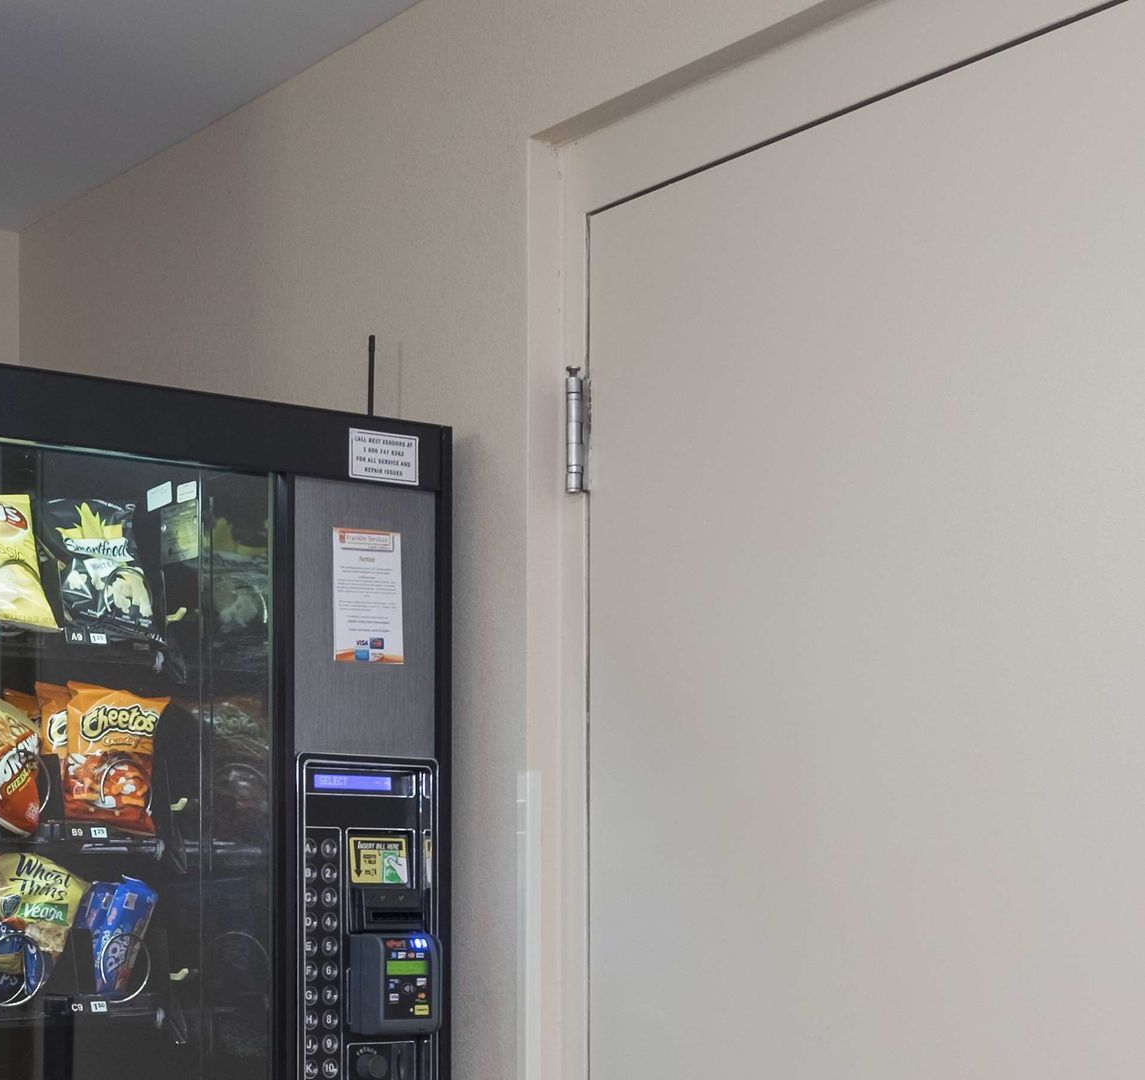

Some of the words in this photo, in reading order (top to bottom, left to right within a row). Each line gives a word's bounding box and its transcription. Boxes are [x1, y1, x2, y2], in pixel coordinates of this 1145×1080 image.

[378, 458, 399, 466] SERVICE
[384, 469, 403, 477] ISSUES
[64, 537, 128, 557] Smartfood
[71, 633, 83, 641] A9
[82, 705, 157, 740] Cheetos
[320, 776, 347, 786] SELECT
[16, 854, 71, 888] Wheat
[10, 877, 67, 902] Thins
[71, 1003, 84, 1011] C9
[356, 1046, 377, 1056] return
